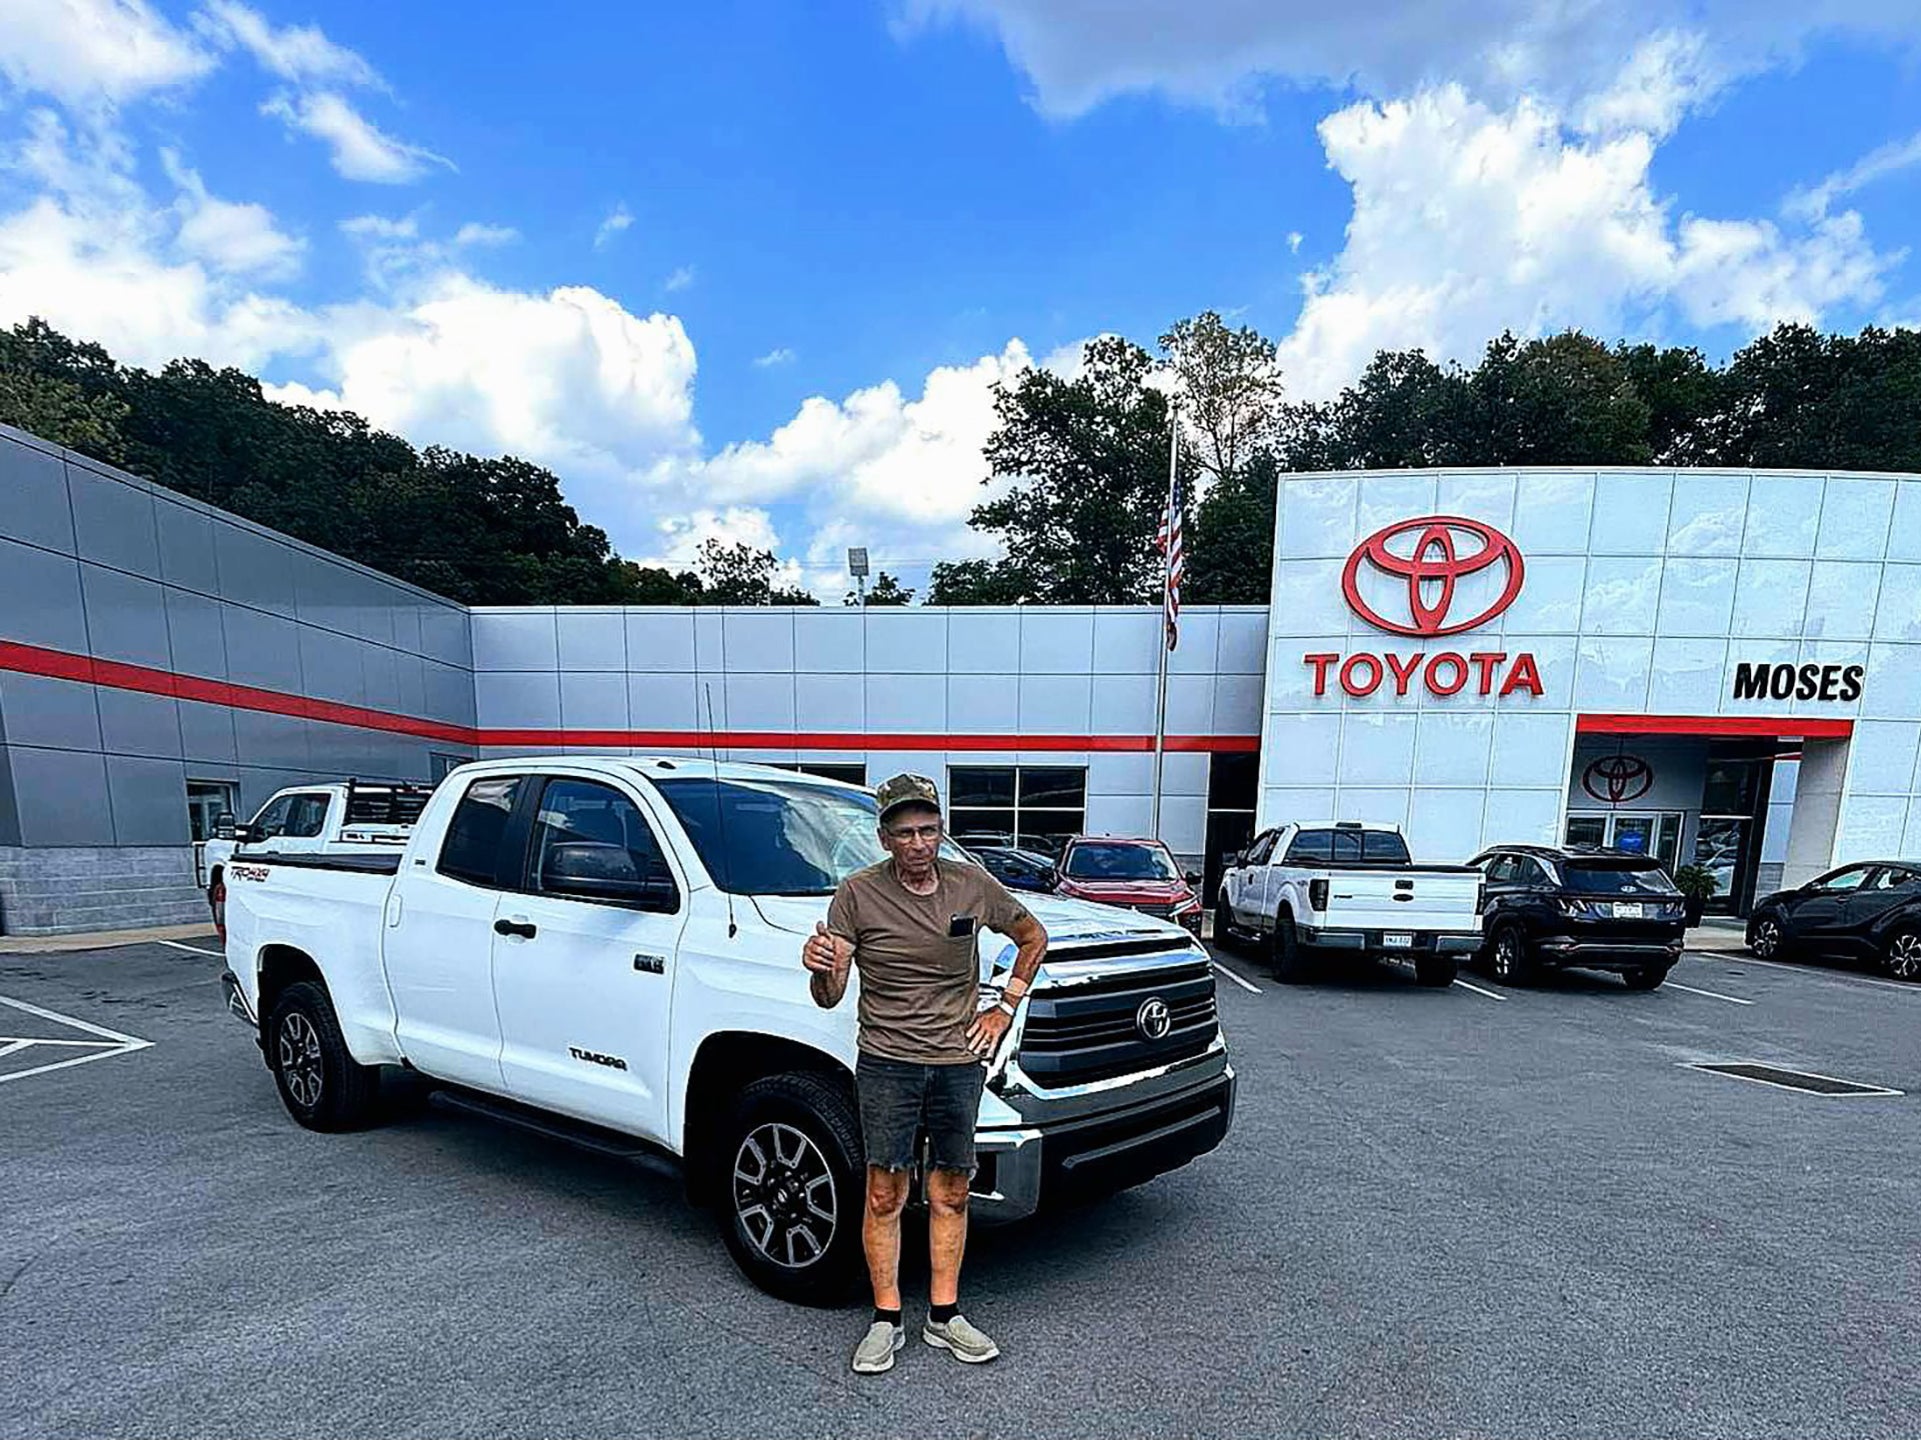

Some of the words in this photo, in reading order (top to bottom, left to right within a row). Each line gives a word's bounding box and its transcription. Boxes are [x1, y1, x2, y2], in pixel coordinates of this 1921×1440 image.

[1303, 652, 1544, 697] TOYOTA
[1733, 662, 1864, 701] MOSES
[569, 1047, 628, 1071] TUNDRA
